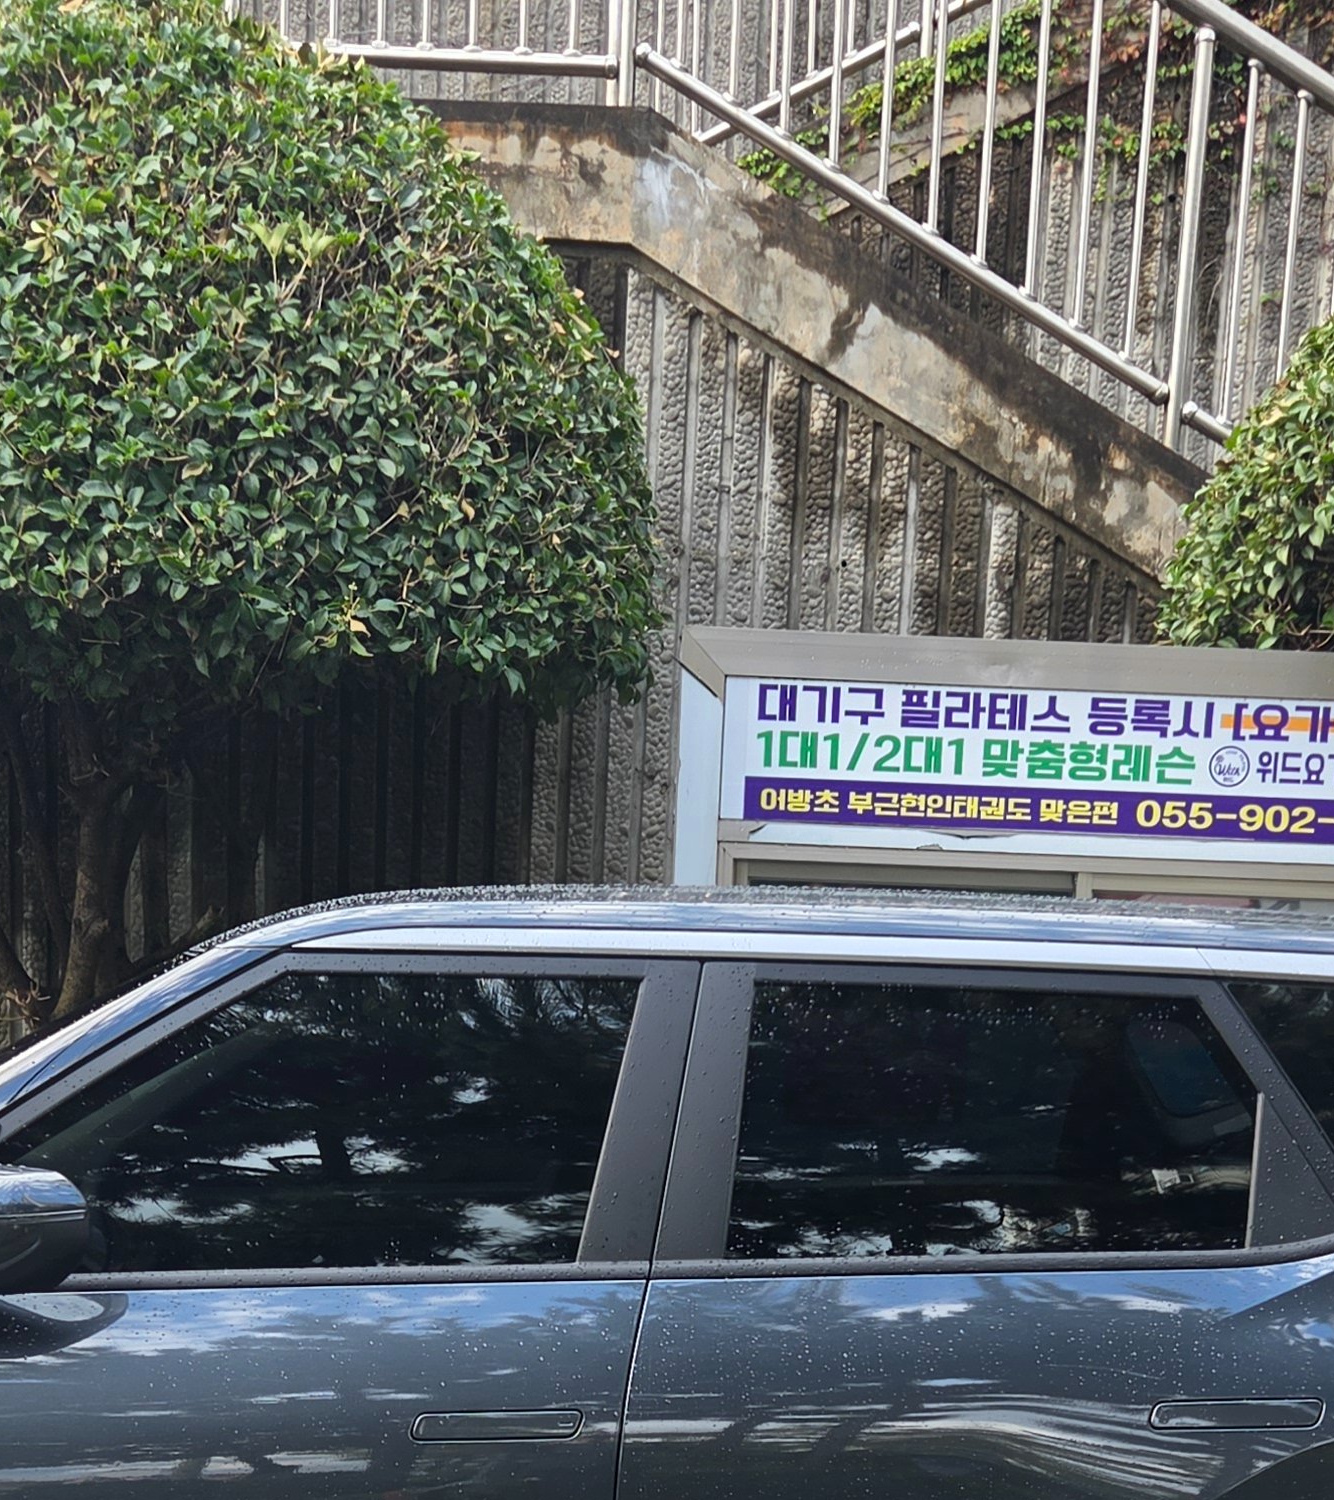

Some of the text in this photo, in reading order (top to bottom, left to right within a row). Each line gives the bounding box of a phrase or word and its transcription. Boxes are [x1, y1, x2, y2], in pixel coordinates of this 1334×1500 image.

[757, 683, 885, 726] 대기구
[900, 689, 1071, 733] 필라테스
[1088, 697, 1214, 738] 등록시
[756, 730, 1196, 785] 1대1/2대1 맞춤형레슨
[760, 788, 840, 813] 어방초
[1039, 799, 1118, 825] 맞은편
